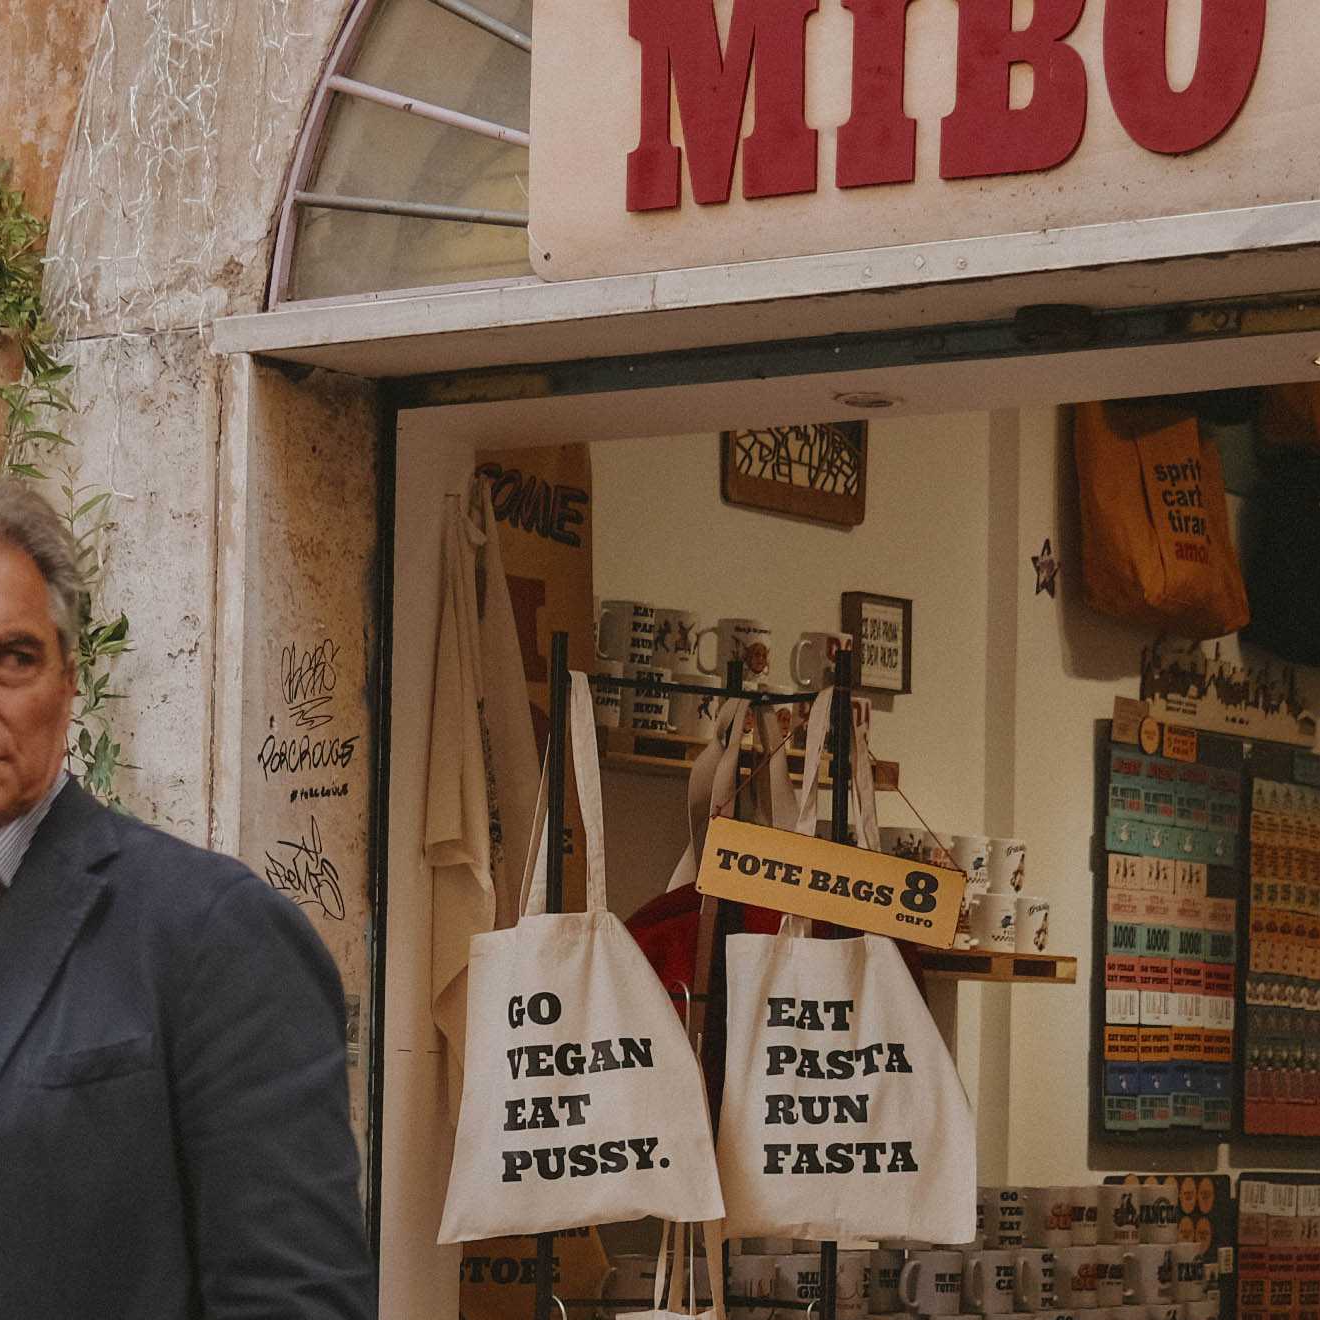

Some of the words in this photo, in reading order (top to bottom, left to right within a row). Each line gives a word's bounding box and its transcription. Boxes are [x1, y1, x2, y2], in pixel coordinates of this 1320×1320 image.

[626, 0, 1267, 213] MIBO
[716, 847, 806, 888] TOTE
[807, 870, 894, 908] BAGS
[899, 871, 939, 914] 8
[895, 912, 934, 929] euro
[507, 991, 562, 1030] GO
[767, 996, 854, 1032] EAT
[506, 1036, 654, 1080] VEGAN
[765, 1042, 913, 1079] PASTA
[503, 1092, 591, 1133] EAT
[763, 1093, 870, 1125] RUN
[501, 1136, 670, 1183] PUSSY.
[762, 1140, 919, 1176] FASTA
